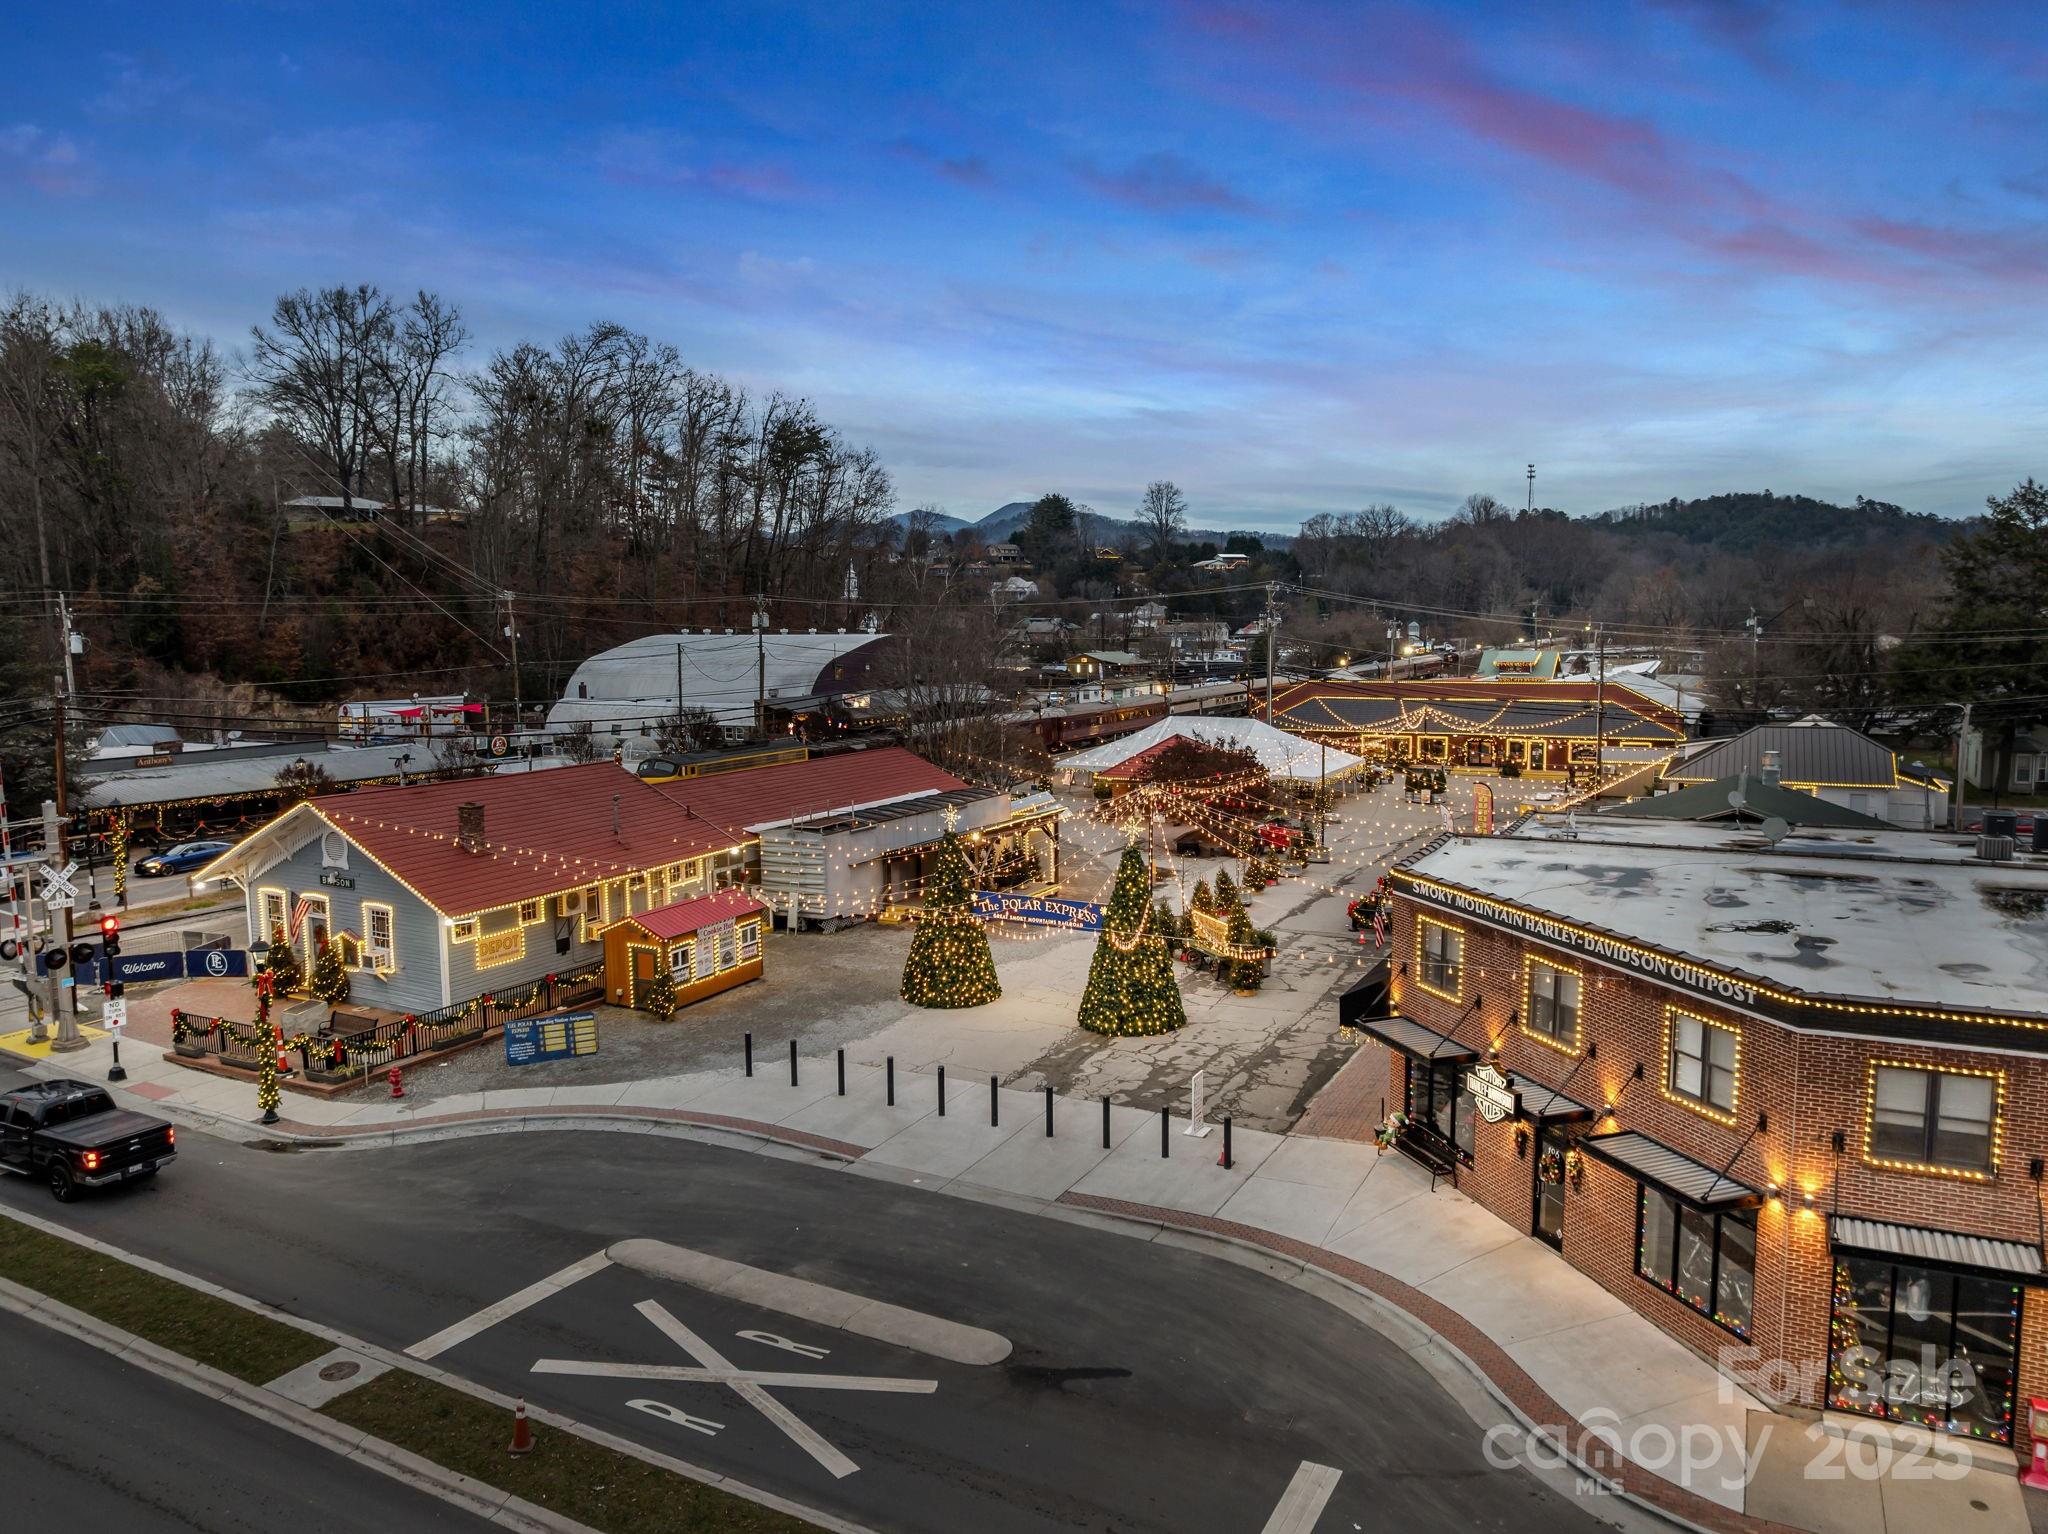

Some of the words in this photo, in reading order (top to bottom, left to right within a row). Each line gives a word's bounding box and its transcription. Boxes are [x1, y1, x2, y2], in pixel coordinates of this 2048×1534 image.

[41, 866, 77, 896] RAILROAD
[43, 863, 77, 899] CROSSING
[49, 900, 75, 908] TRACKS
[979, 900, 1000, 913] The
[1002, 898, 1042, 911] POLAR
[1045, 901, 1098, 925] EXPRESS
[703, 926, 723, 937] Cookie
[723, 921, 734, 931] Hut
[1009, 914, 1027, 922] SMOKY
[1028, 916, 1057, 926] MOUNTAINS
[480, 934, 519, 956] DEPOT
[1412, 881, 1454, 904] SMOKY
[1455, 896, 1524, 928] MOUNTAIN
[1525, 916, 1667, 976] HARLEY-DAVIDSON
[1669, 964, 1757, 1005] OUTPOST
[122, 960, 166, 975] Welcome
